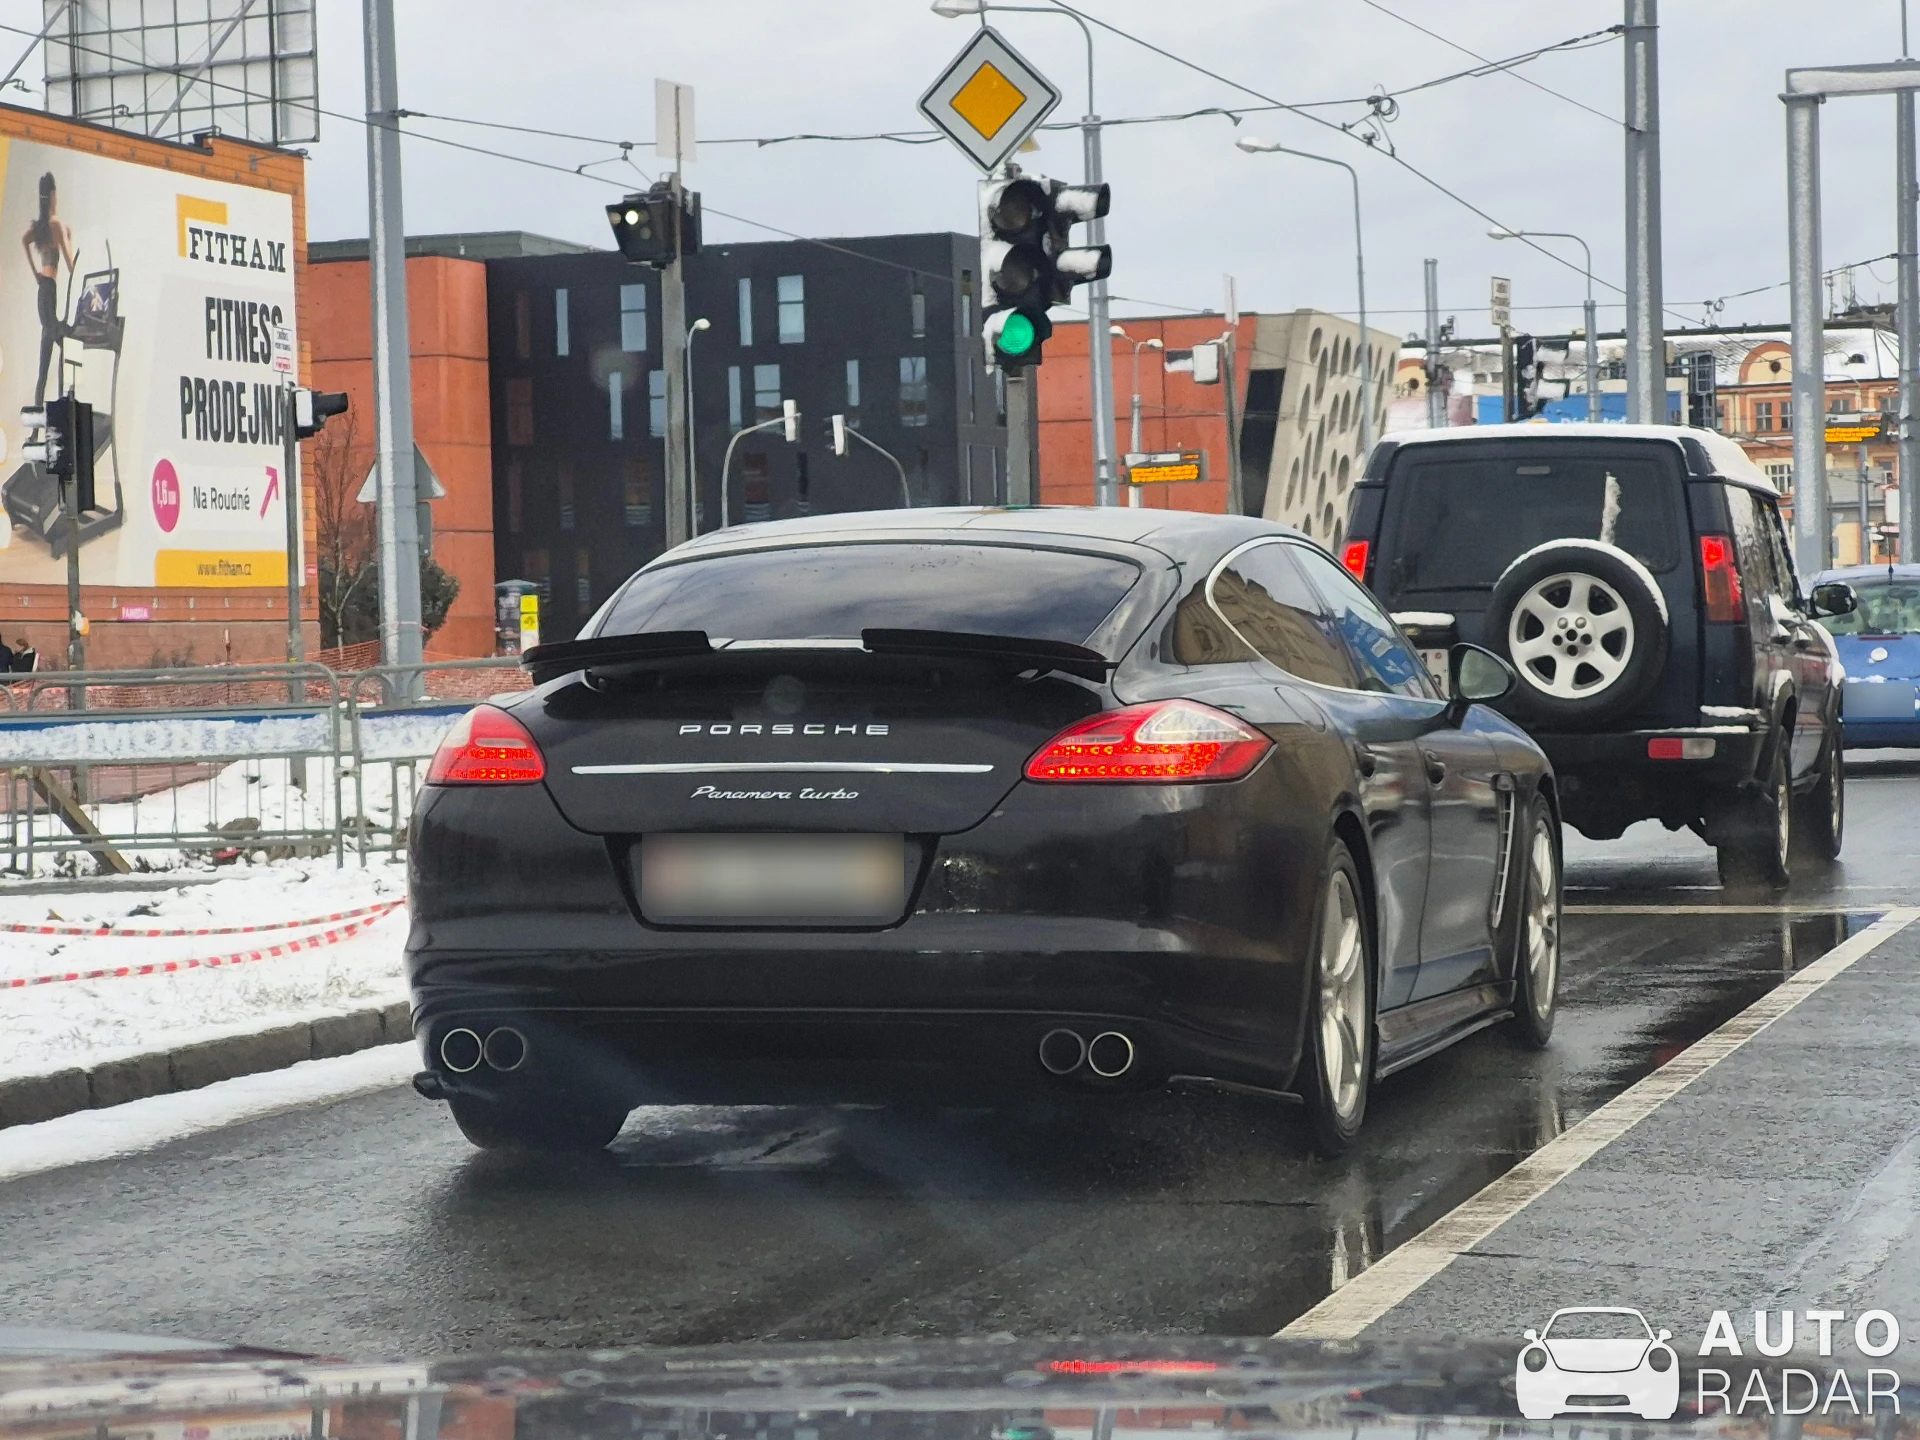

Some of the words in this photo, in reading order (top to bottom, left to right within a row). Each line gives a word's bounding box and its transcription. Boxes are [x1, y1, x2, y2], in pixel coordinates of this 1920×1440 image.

[188, 226, 286, 273] FITHAM
[193, 486, 207, 510] Na
[210, 487, 250, 510] Roudné
[679, 723, 889, 736] PORSCHE
[691, 785, 791, 800] Panamera
[799, 786, 859, 800] turbo
